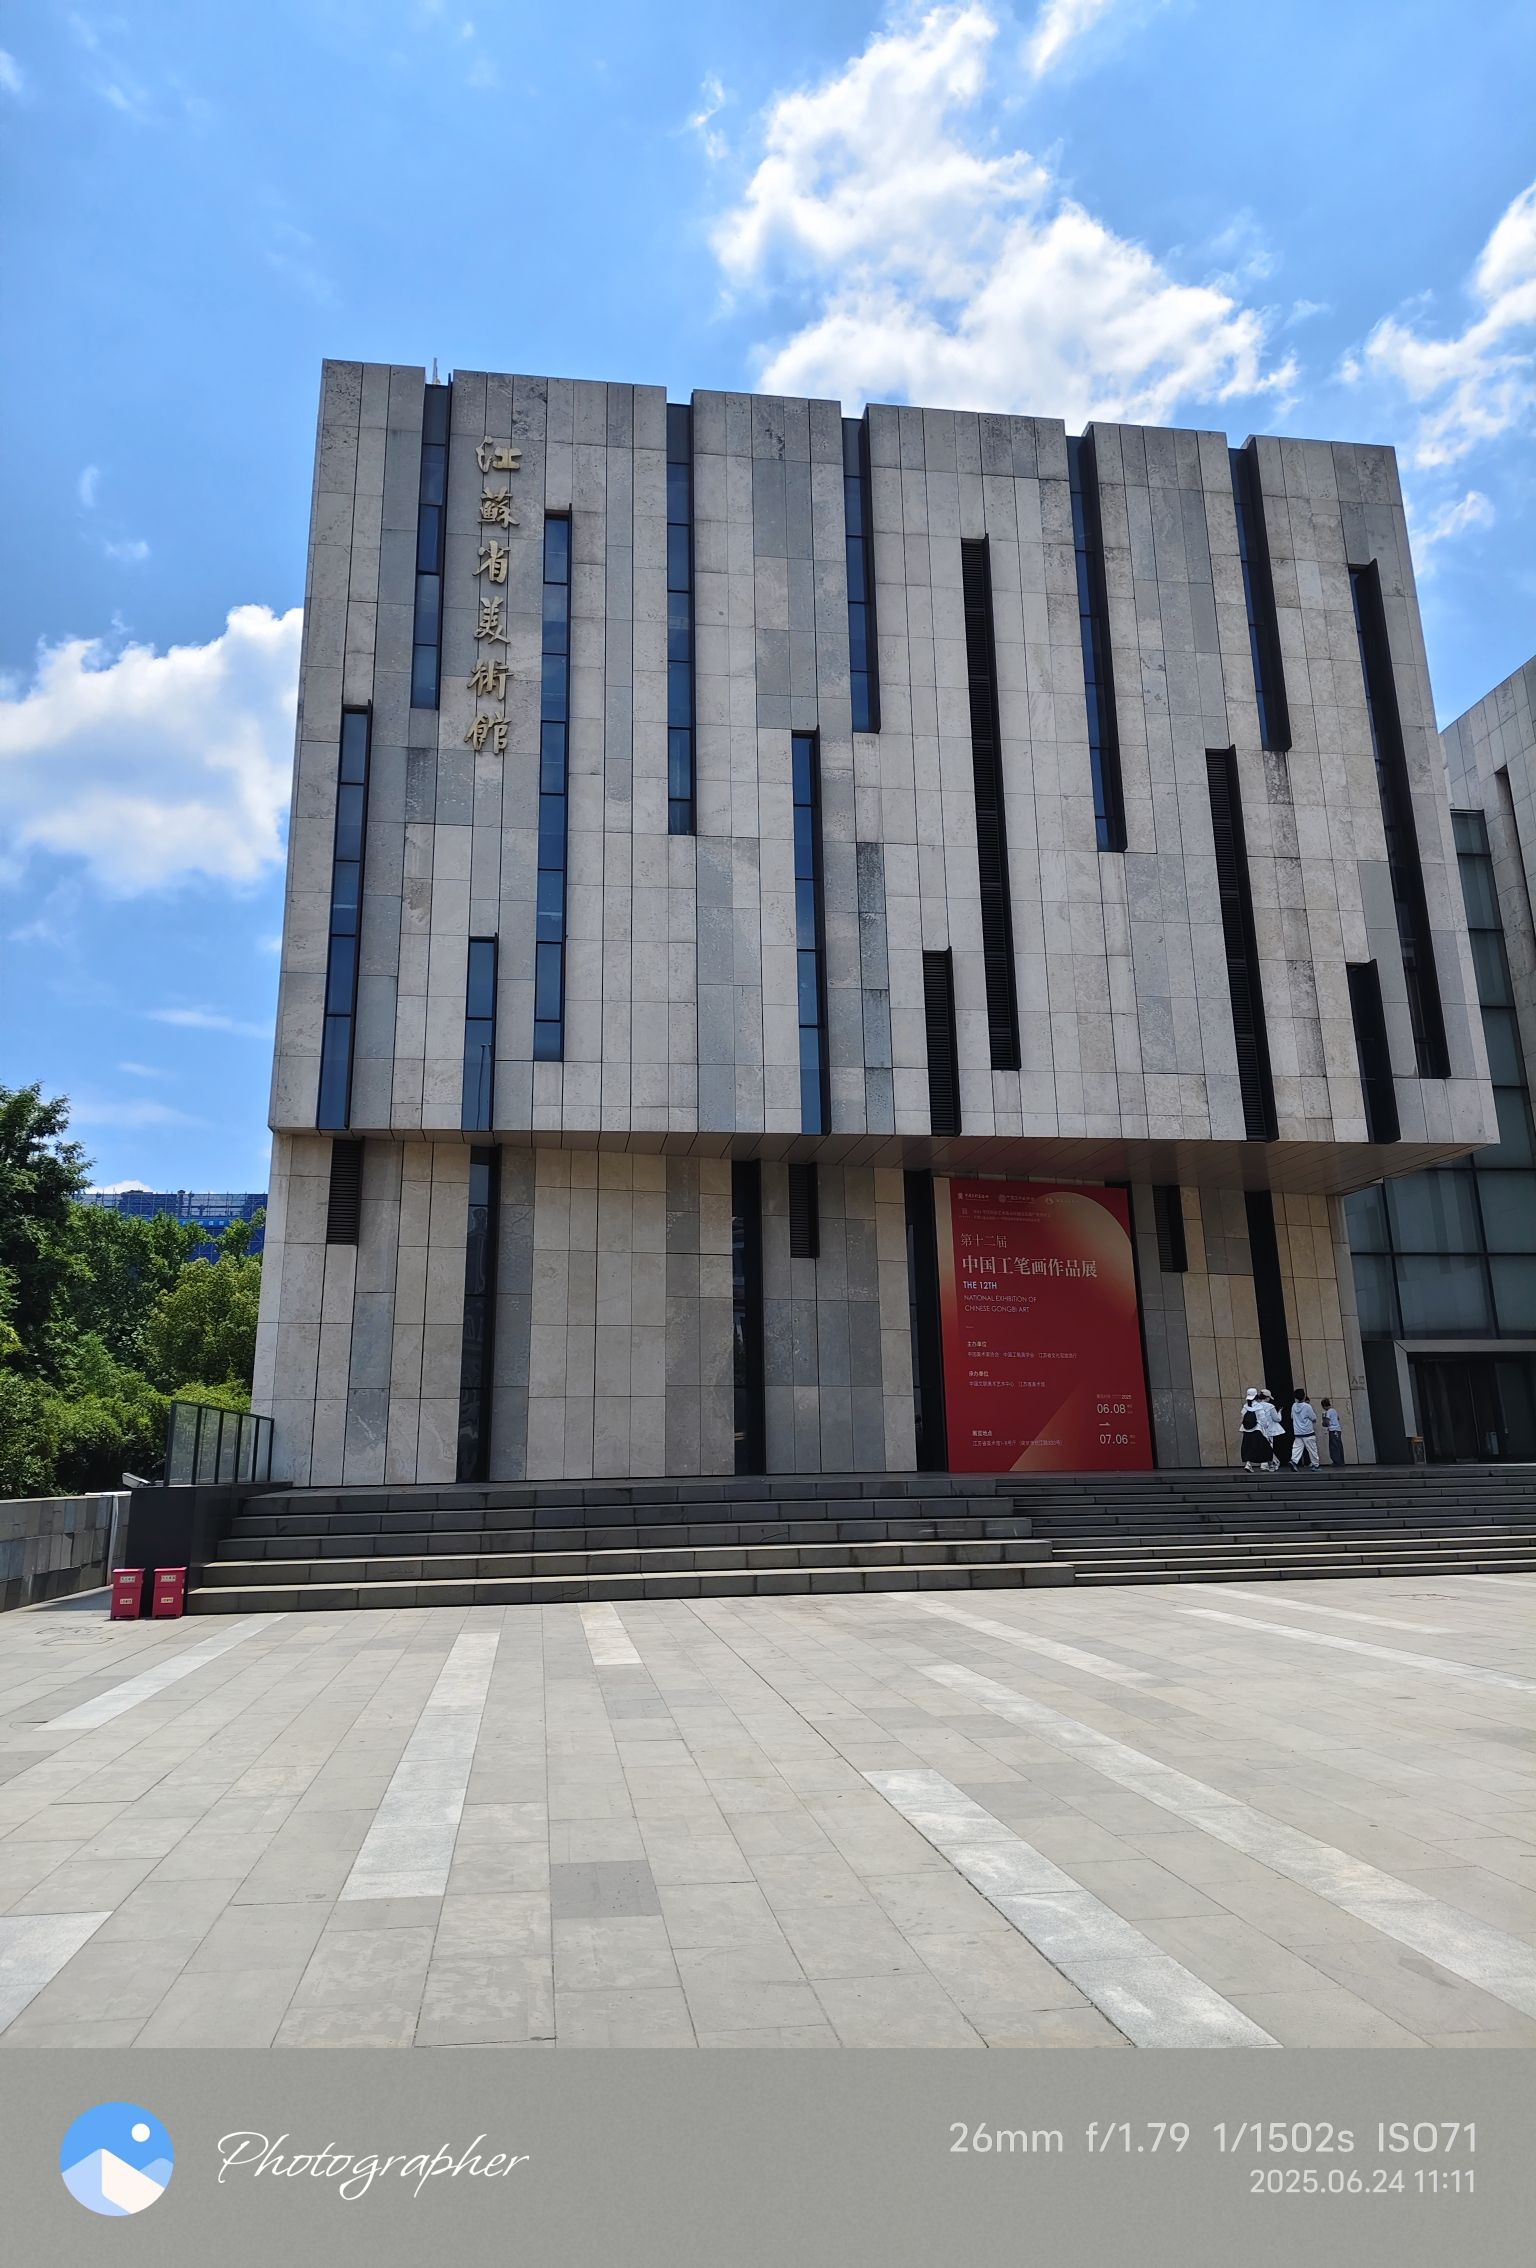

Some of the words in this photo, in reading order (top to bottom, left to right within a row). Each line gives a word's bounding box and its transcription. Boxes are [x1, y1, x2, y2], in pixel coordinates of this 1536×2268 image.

[464, 435, 523, 754] 江蘇省美術館
[960, 1233, 1007, 1248] 第十二届
[962, 1255, 1097, 1278] 中国工笔画作品展
[963, 1281, 977, 1289] THE
[979, 1281, 998, 1290] 12TH
[1096, 1403, 1126, 1414] 06.08
[1099, 1434, 1128, 1445] 07.06
